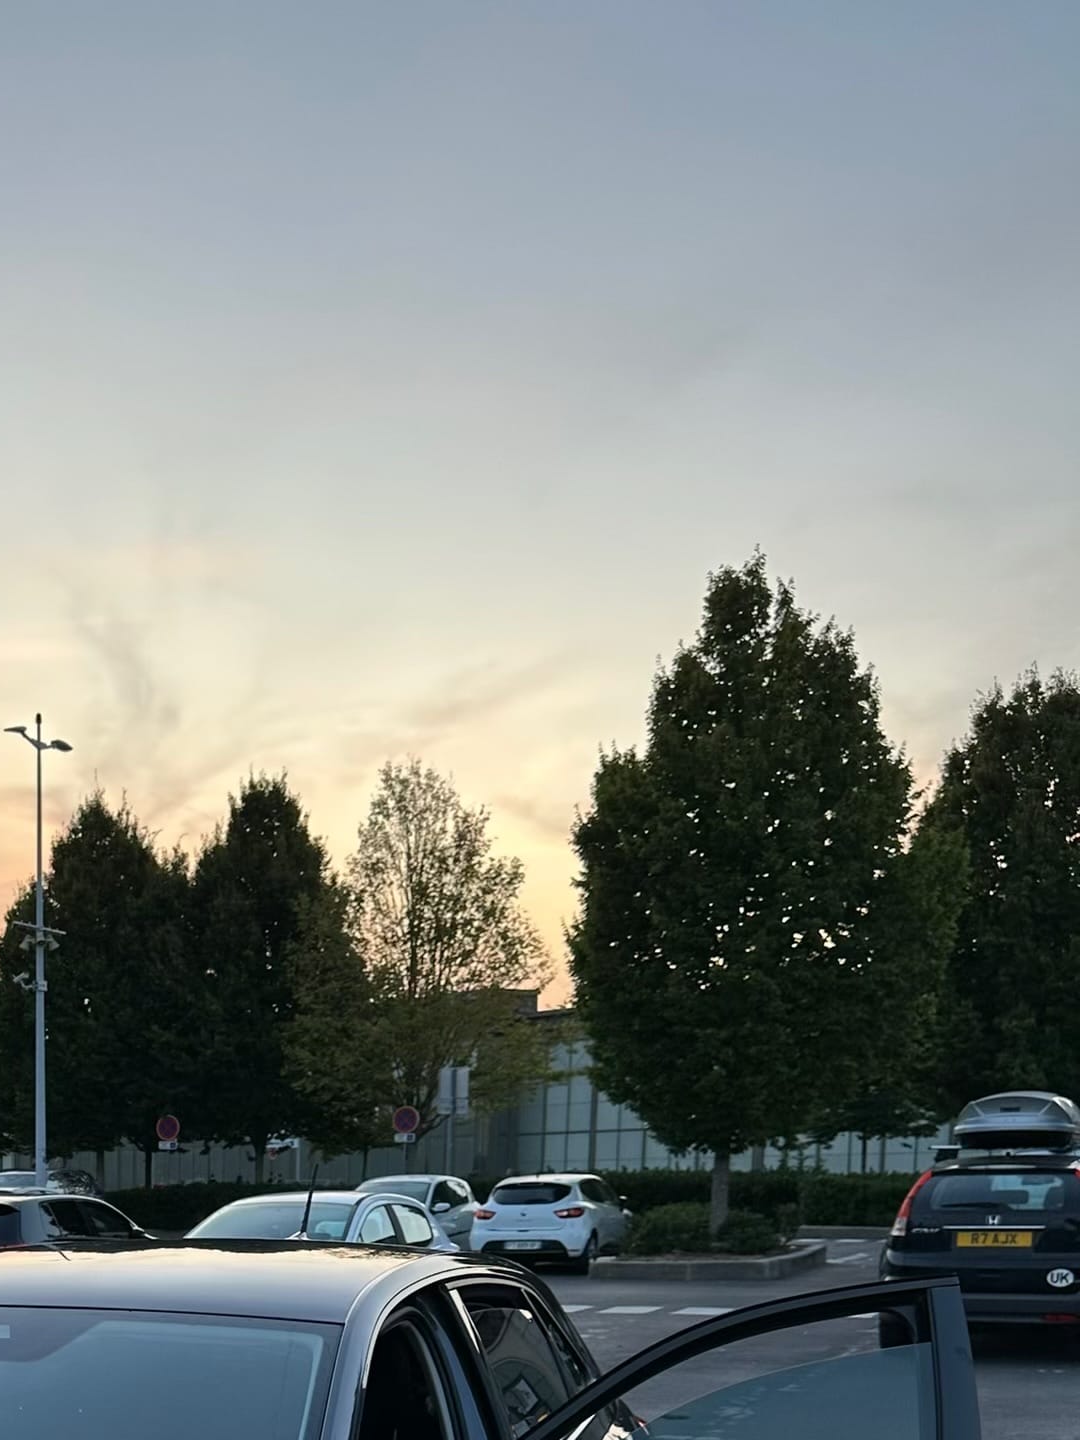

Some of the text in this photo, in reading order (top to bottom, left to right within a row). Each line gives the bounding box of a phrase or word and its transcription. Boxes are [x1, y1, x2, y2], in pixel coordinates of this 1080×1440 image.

[970, 1232, 1017, 1244] R7 AJX
[1050, 1272, 1070, 1284] UK
